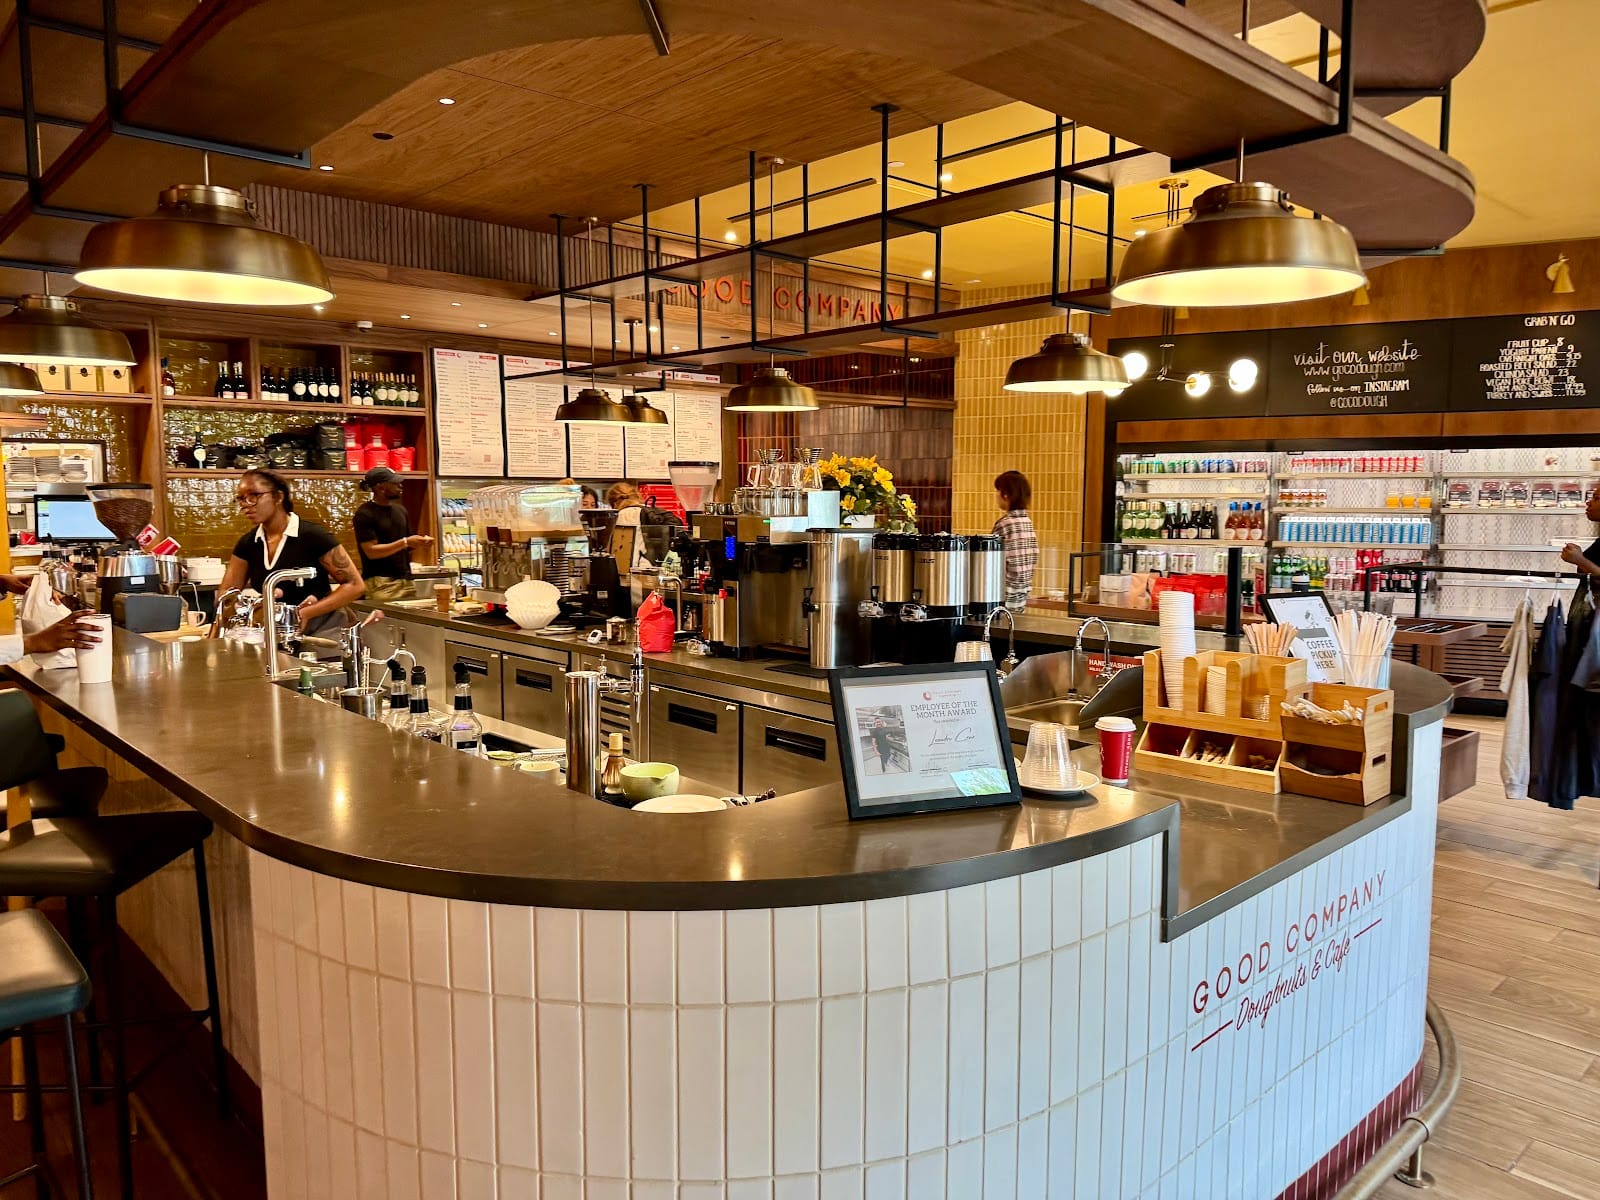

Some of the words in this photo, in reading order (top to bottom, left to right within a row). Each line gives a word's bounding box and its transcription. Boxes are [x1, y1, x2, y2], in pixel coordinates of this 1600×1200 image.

[664, 274, 752, 305] OOD
[774, 286, 901, 322] COMPANY
[1524, 316, 1548, 326] GRAB
[1560, 314, 1576, 326] GO
[1507, 340, 1530, 348] FRUIT
[1532, 338, 1549, 348] CUP
[1294, 341, 1330, 366] visit
[1332, 351, 1363, 363] our
[1368, 339, 1422, 362] website
[1500, 348, 1529, 356] YOGURT
[1480, 363, 1512, 372] ROASTED
[1514, 360, 1532, 370] BEET
[1533, 360, 1557, 369] SALAD
[1526, 370, 1550, 378] SALAD
[1306, 384, 1331, 395] follow
[1364, 380, 1410, 392] INSTAGRAM
[1486, 392, 1513, 400] TURKEY
[1514, 391, 1530, 399] AND
[1531, 390, 1554, 398] SWISS
[1306, 640, 1335, 650] COFFEE
[1310, 650, 1336, 660] PICKUP
[1314, 660, 1336, 670] HERE
[910, 702, 950, 712] EMPLOYEE
[916, 710, 946, 720] MONTH
[947, 708, 976, 717] AWARD
[1193, 941, 1271, 1014] GOOD
[1286, 868, 1386, 953] COMPANY
[1236, 962, 1308, 1031] Doughnuts
[1311, 948, 1322, 980] &
